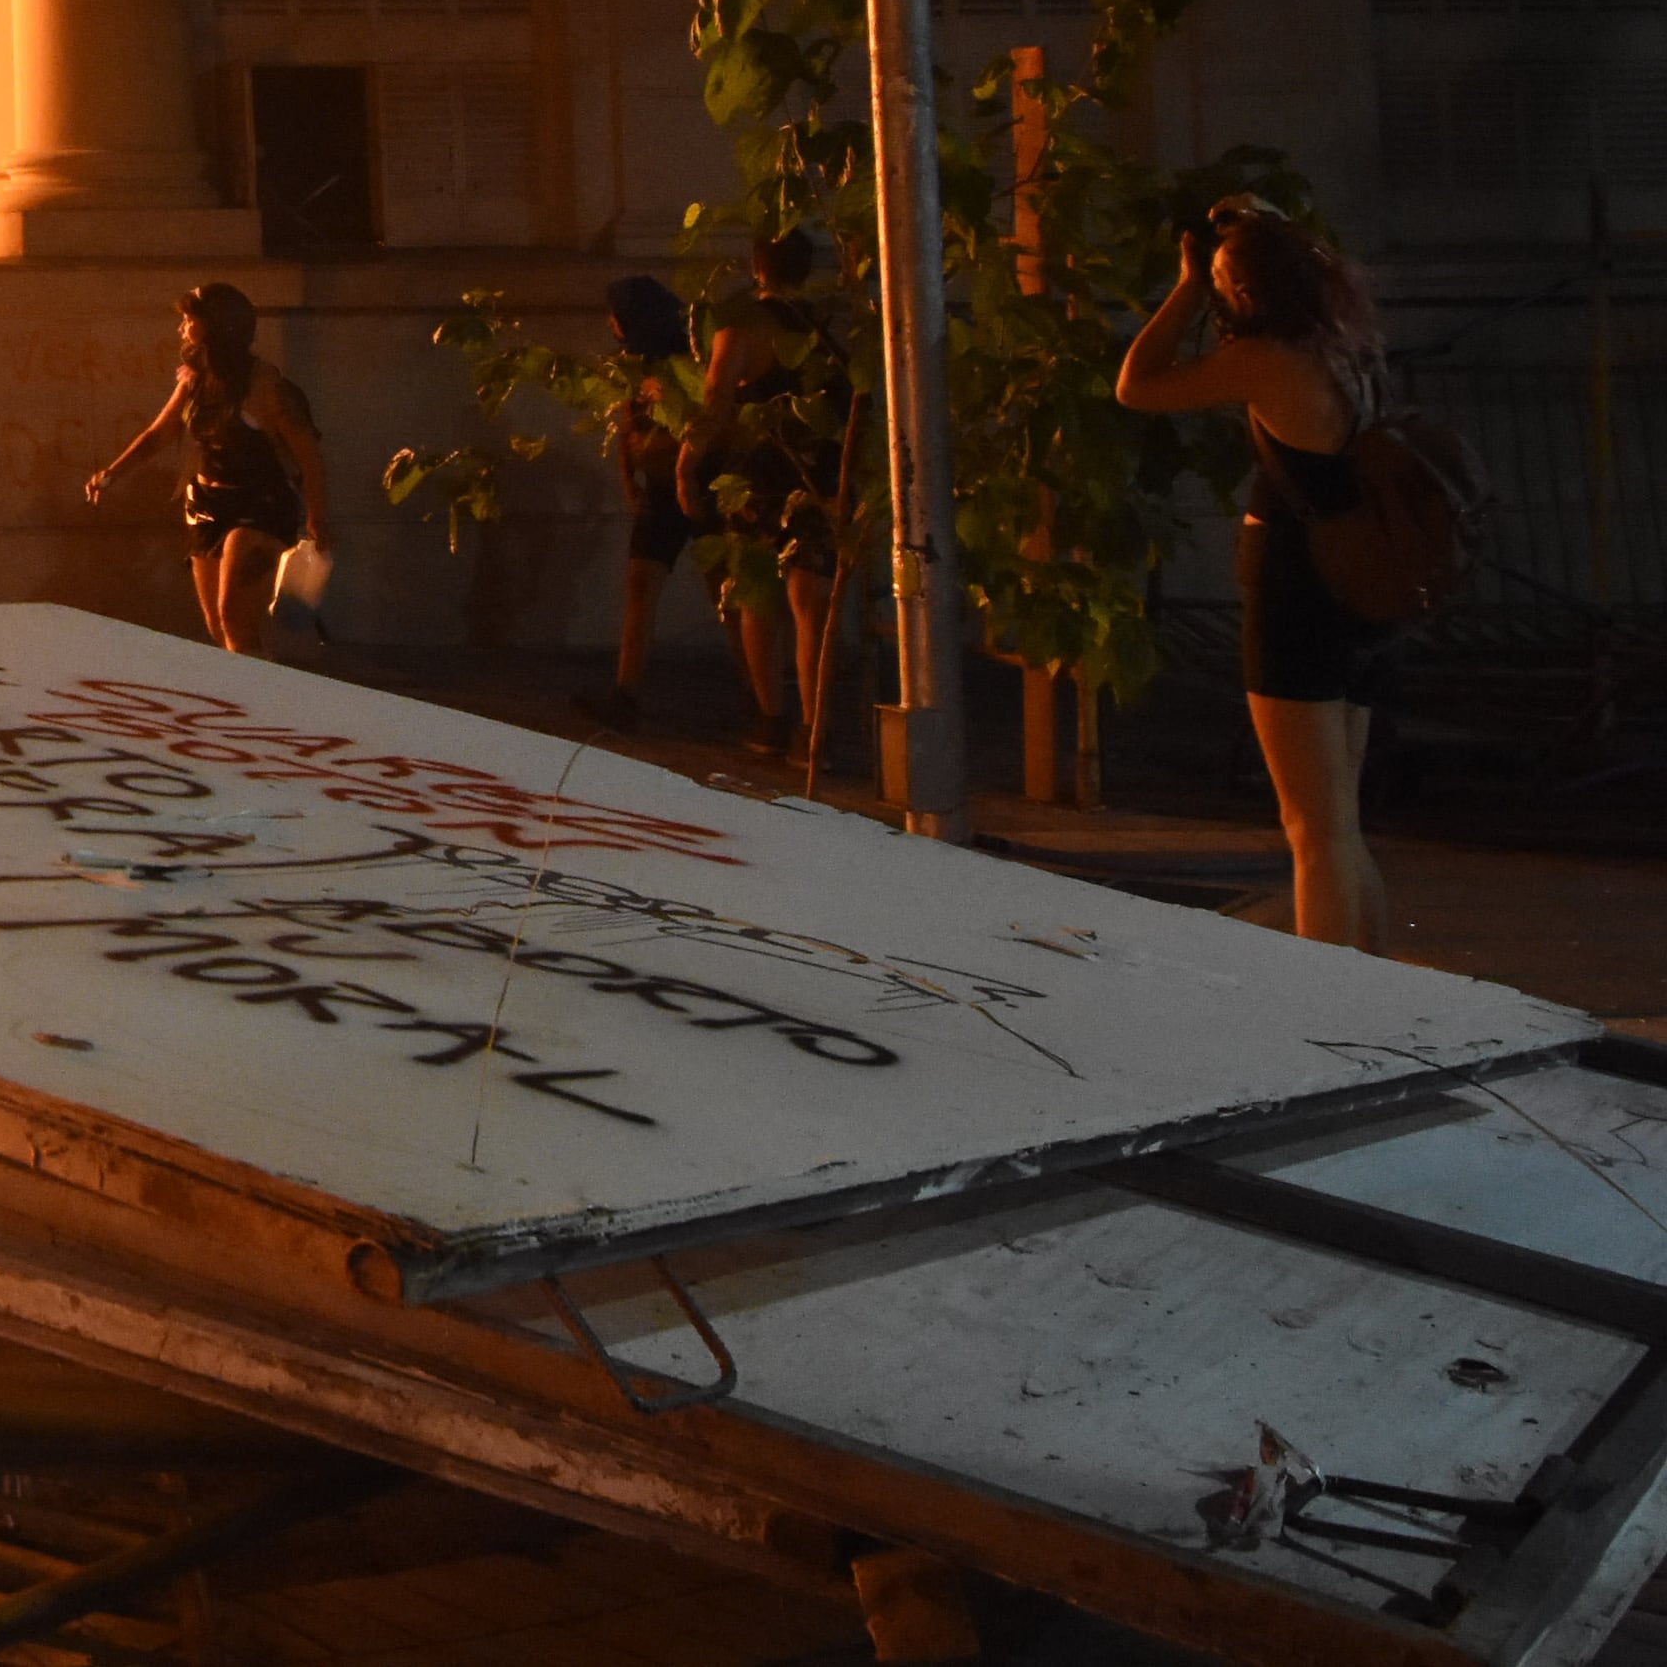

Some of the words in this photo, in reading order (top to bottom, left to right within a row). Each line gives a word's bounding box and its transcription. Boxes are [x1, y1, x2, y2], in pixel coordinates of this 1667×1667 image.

[44, 678, 754, 867] SUAREZ
[139, 898, 421, 962] TU
[258, 897, 904, 1071] ABORTO
